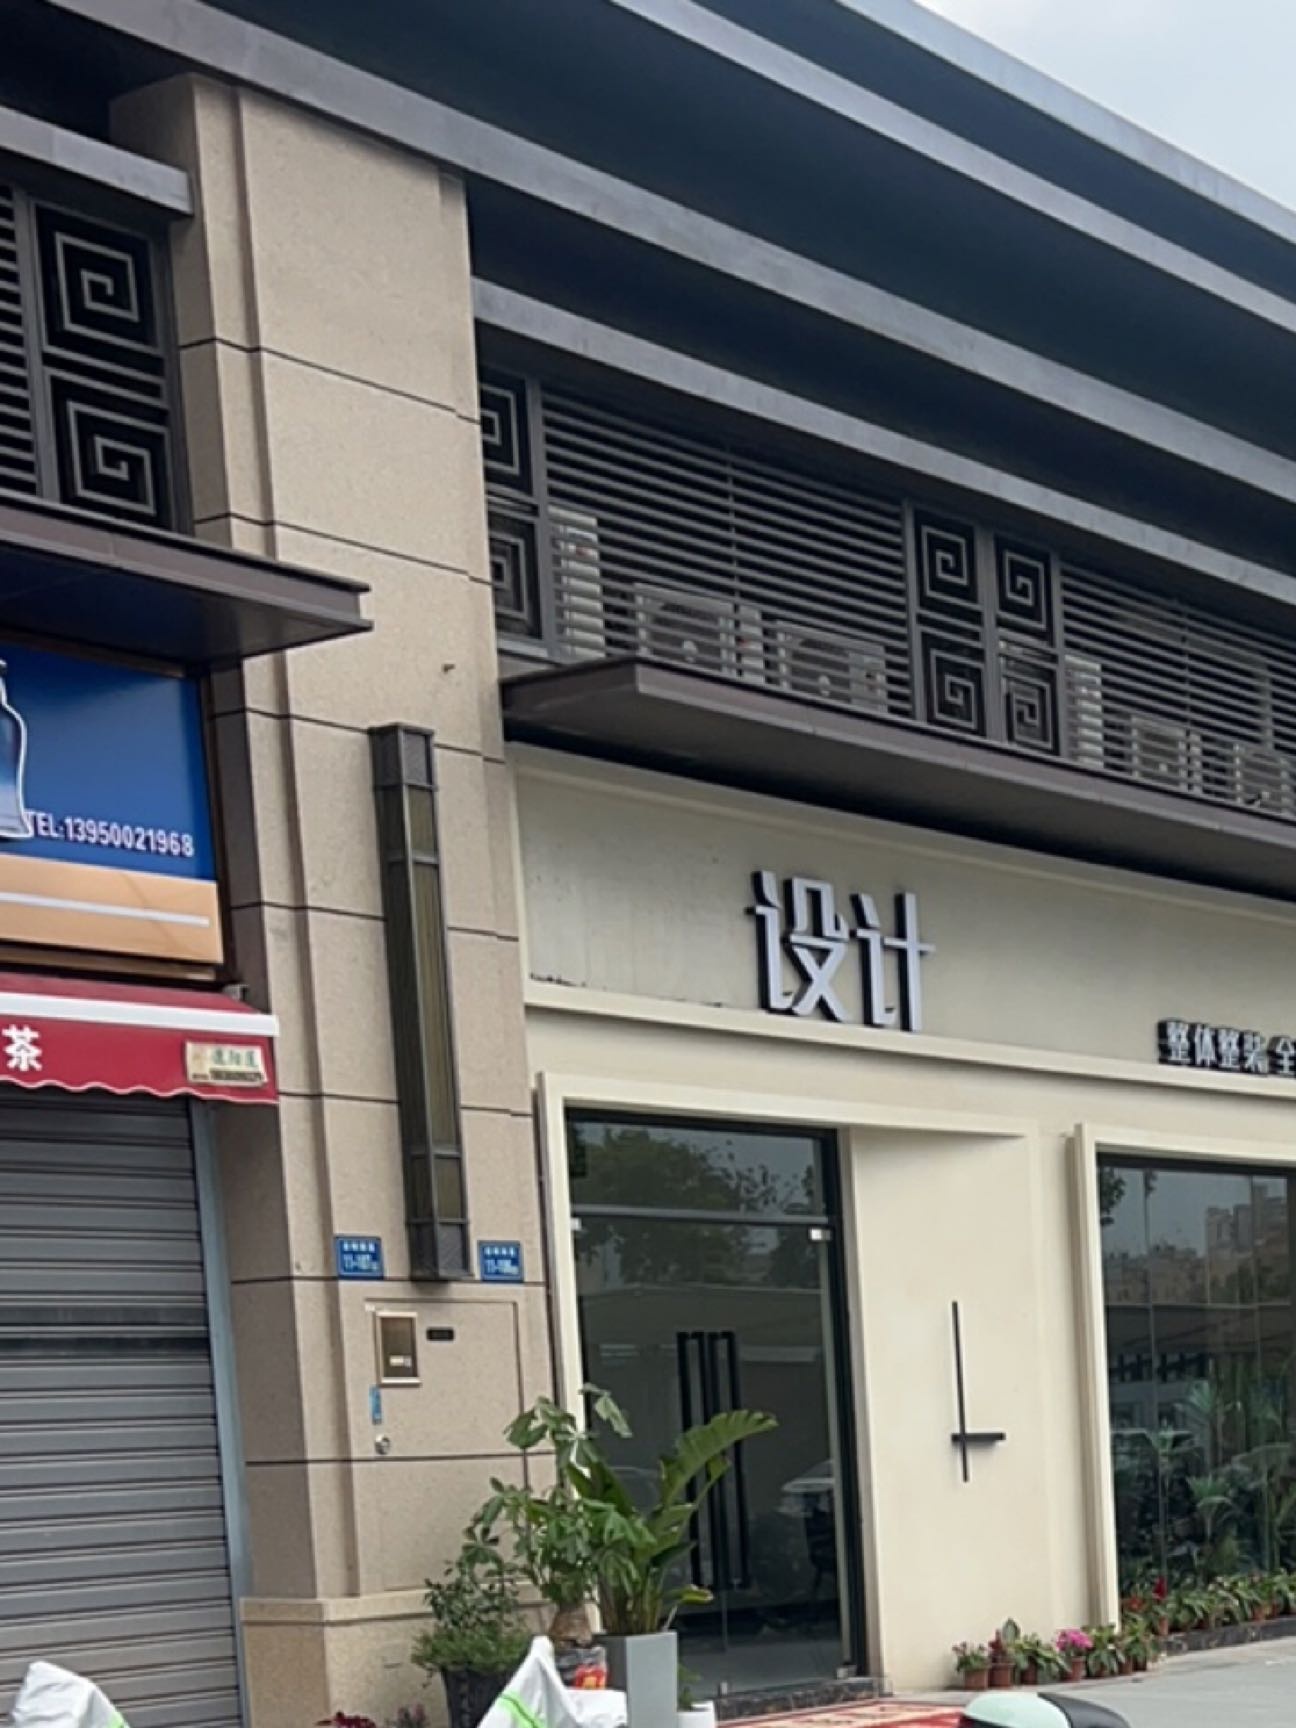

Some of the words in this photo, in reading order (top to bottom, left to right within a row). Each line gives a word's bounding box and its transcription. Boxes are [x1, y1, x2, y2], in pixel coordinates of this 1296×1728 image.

[745, 870, 936, 1032] 设计
[2, 1024, 42, 1072] 茶
[1159, 1020, 1267, 1073] 整体整装
